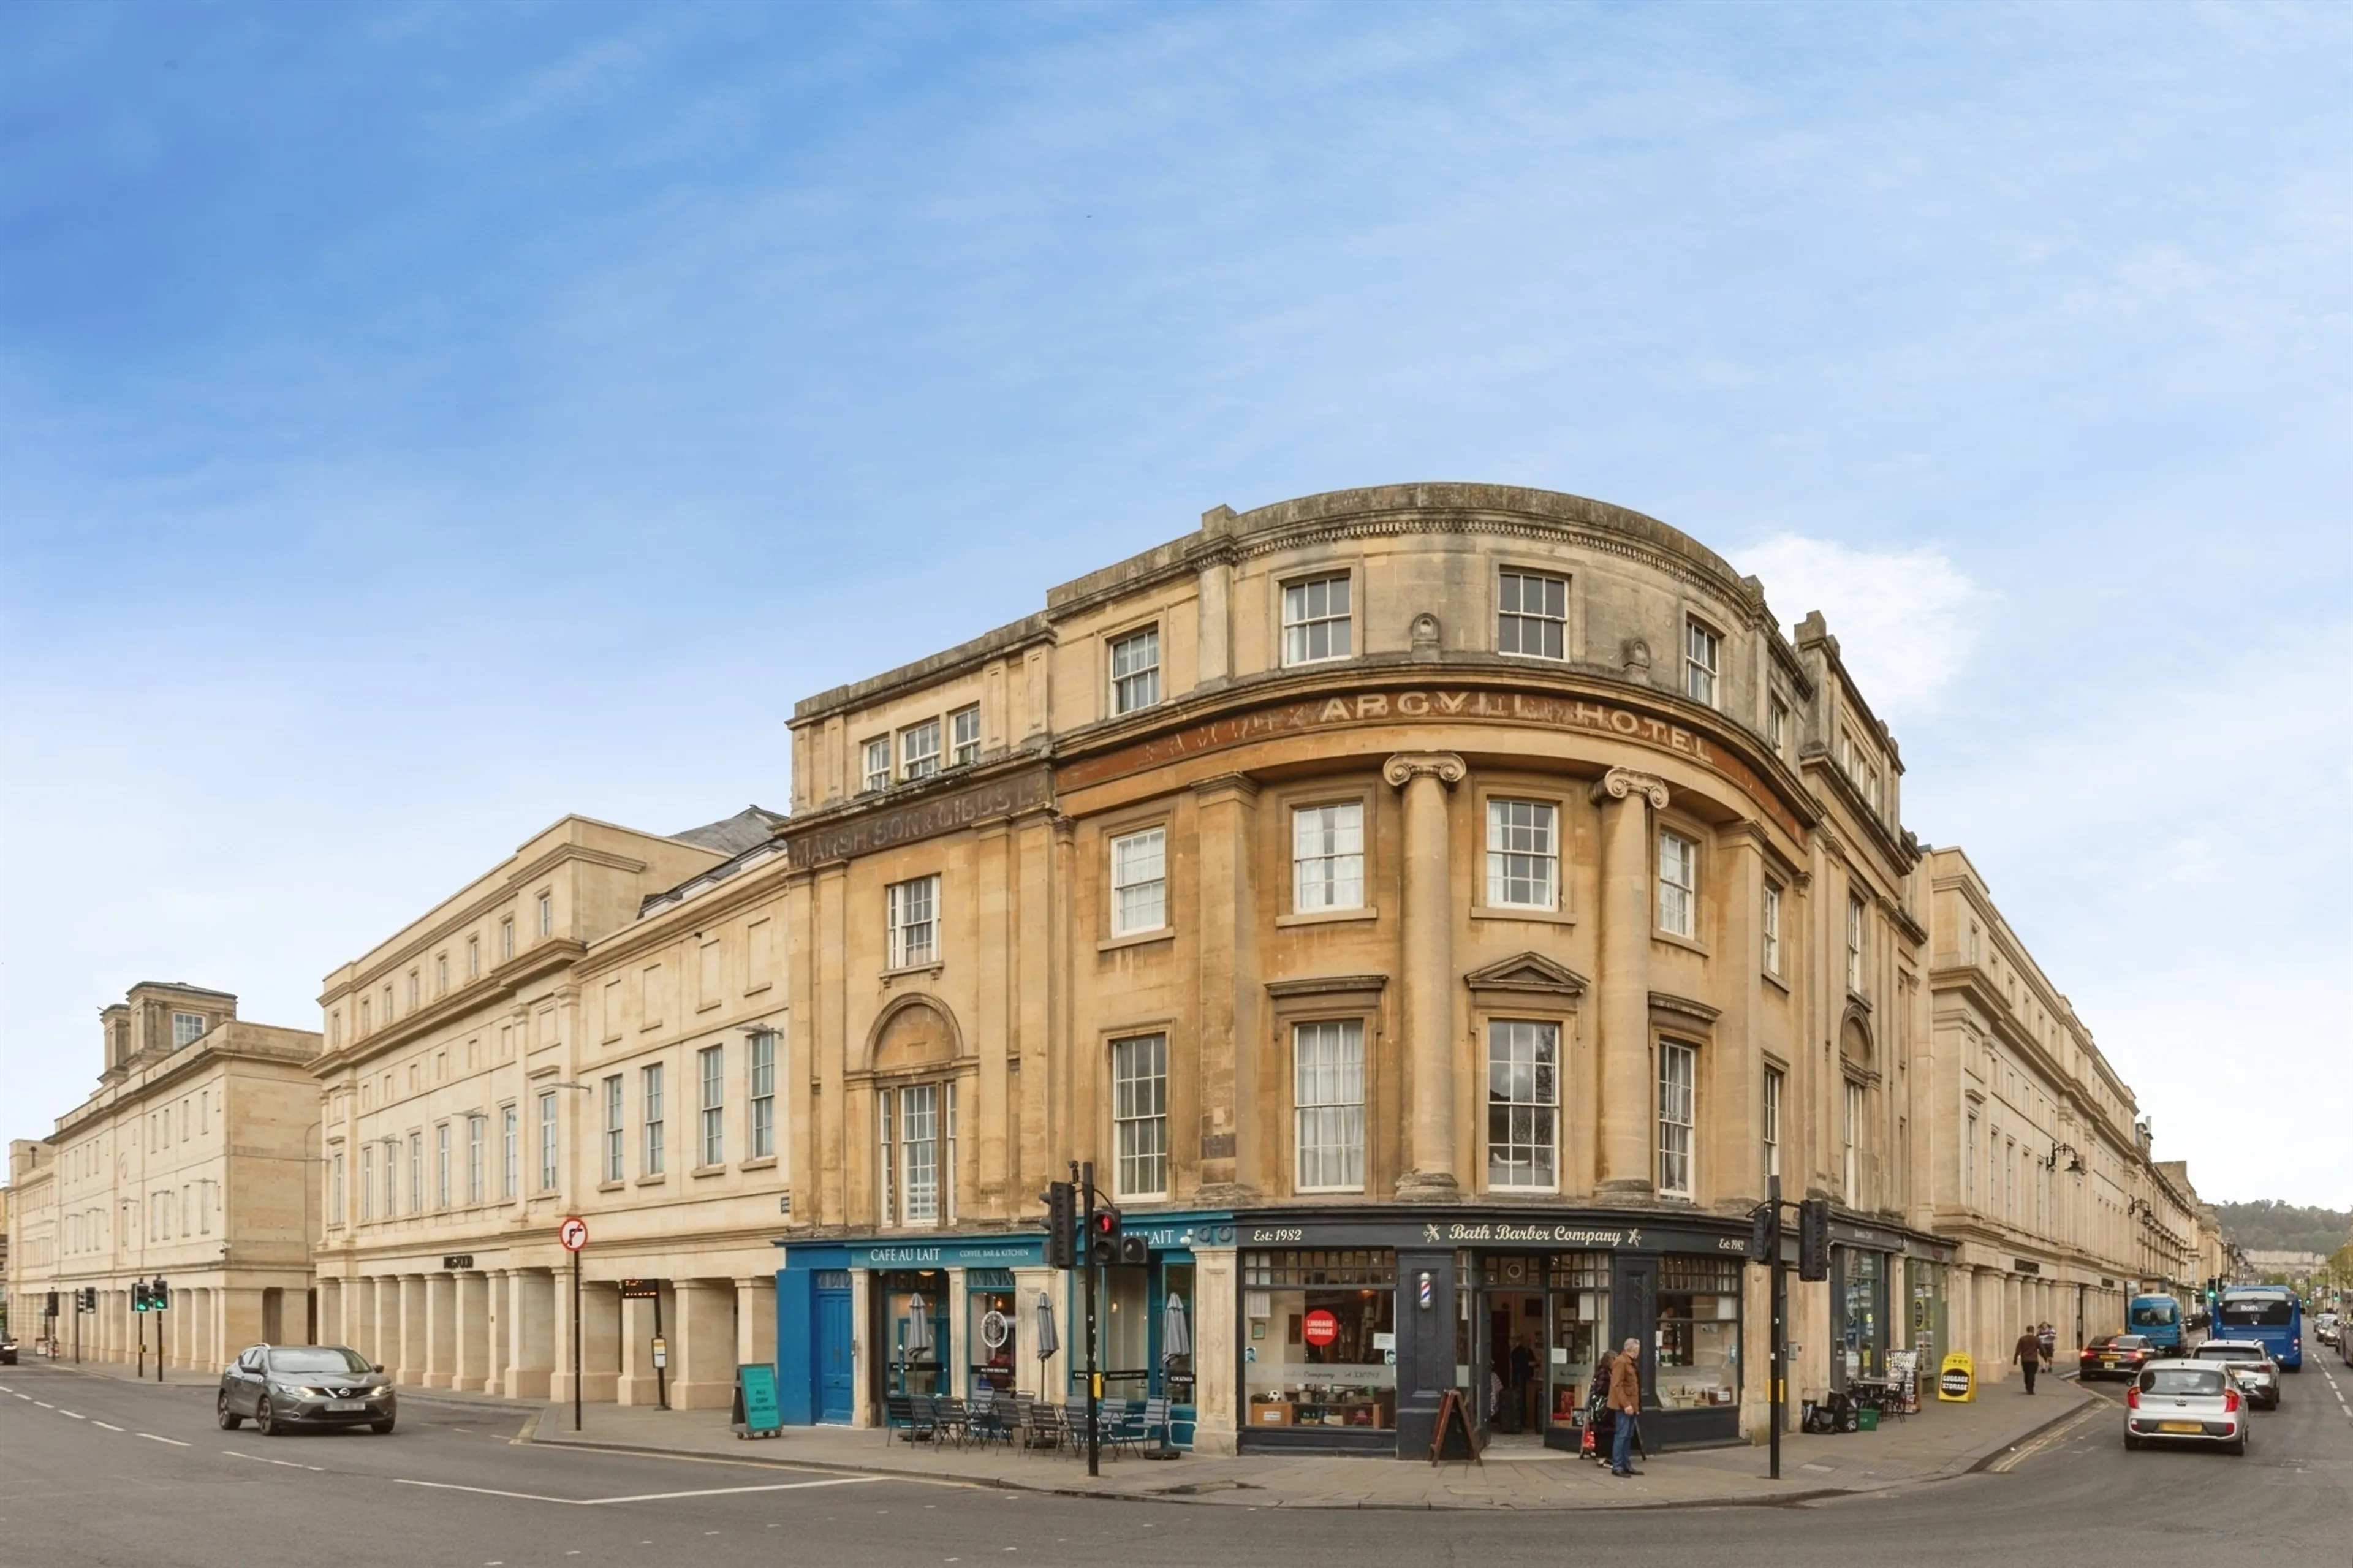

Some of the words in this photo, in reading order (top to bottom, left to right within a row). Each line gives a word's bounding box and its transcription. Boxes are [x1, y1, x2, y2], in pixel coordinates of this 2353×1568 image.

[1575, 701, 1714, 763] HOTEL
[874, 813, 920, 846] SON
[1275, 1229, 1302, 1241] 1982
[1449, 1224, 1491, 1240] Bath
[1495, 1224, 1551, 1240] Barber
[1554, 1225, 1623, 1246] Company
[898, 1248, 914, 1261] AU
[917, 1248, 941, 1260] LAIT
[1942, 1382, 1968, 1391] STORAGE
